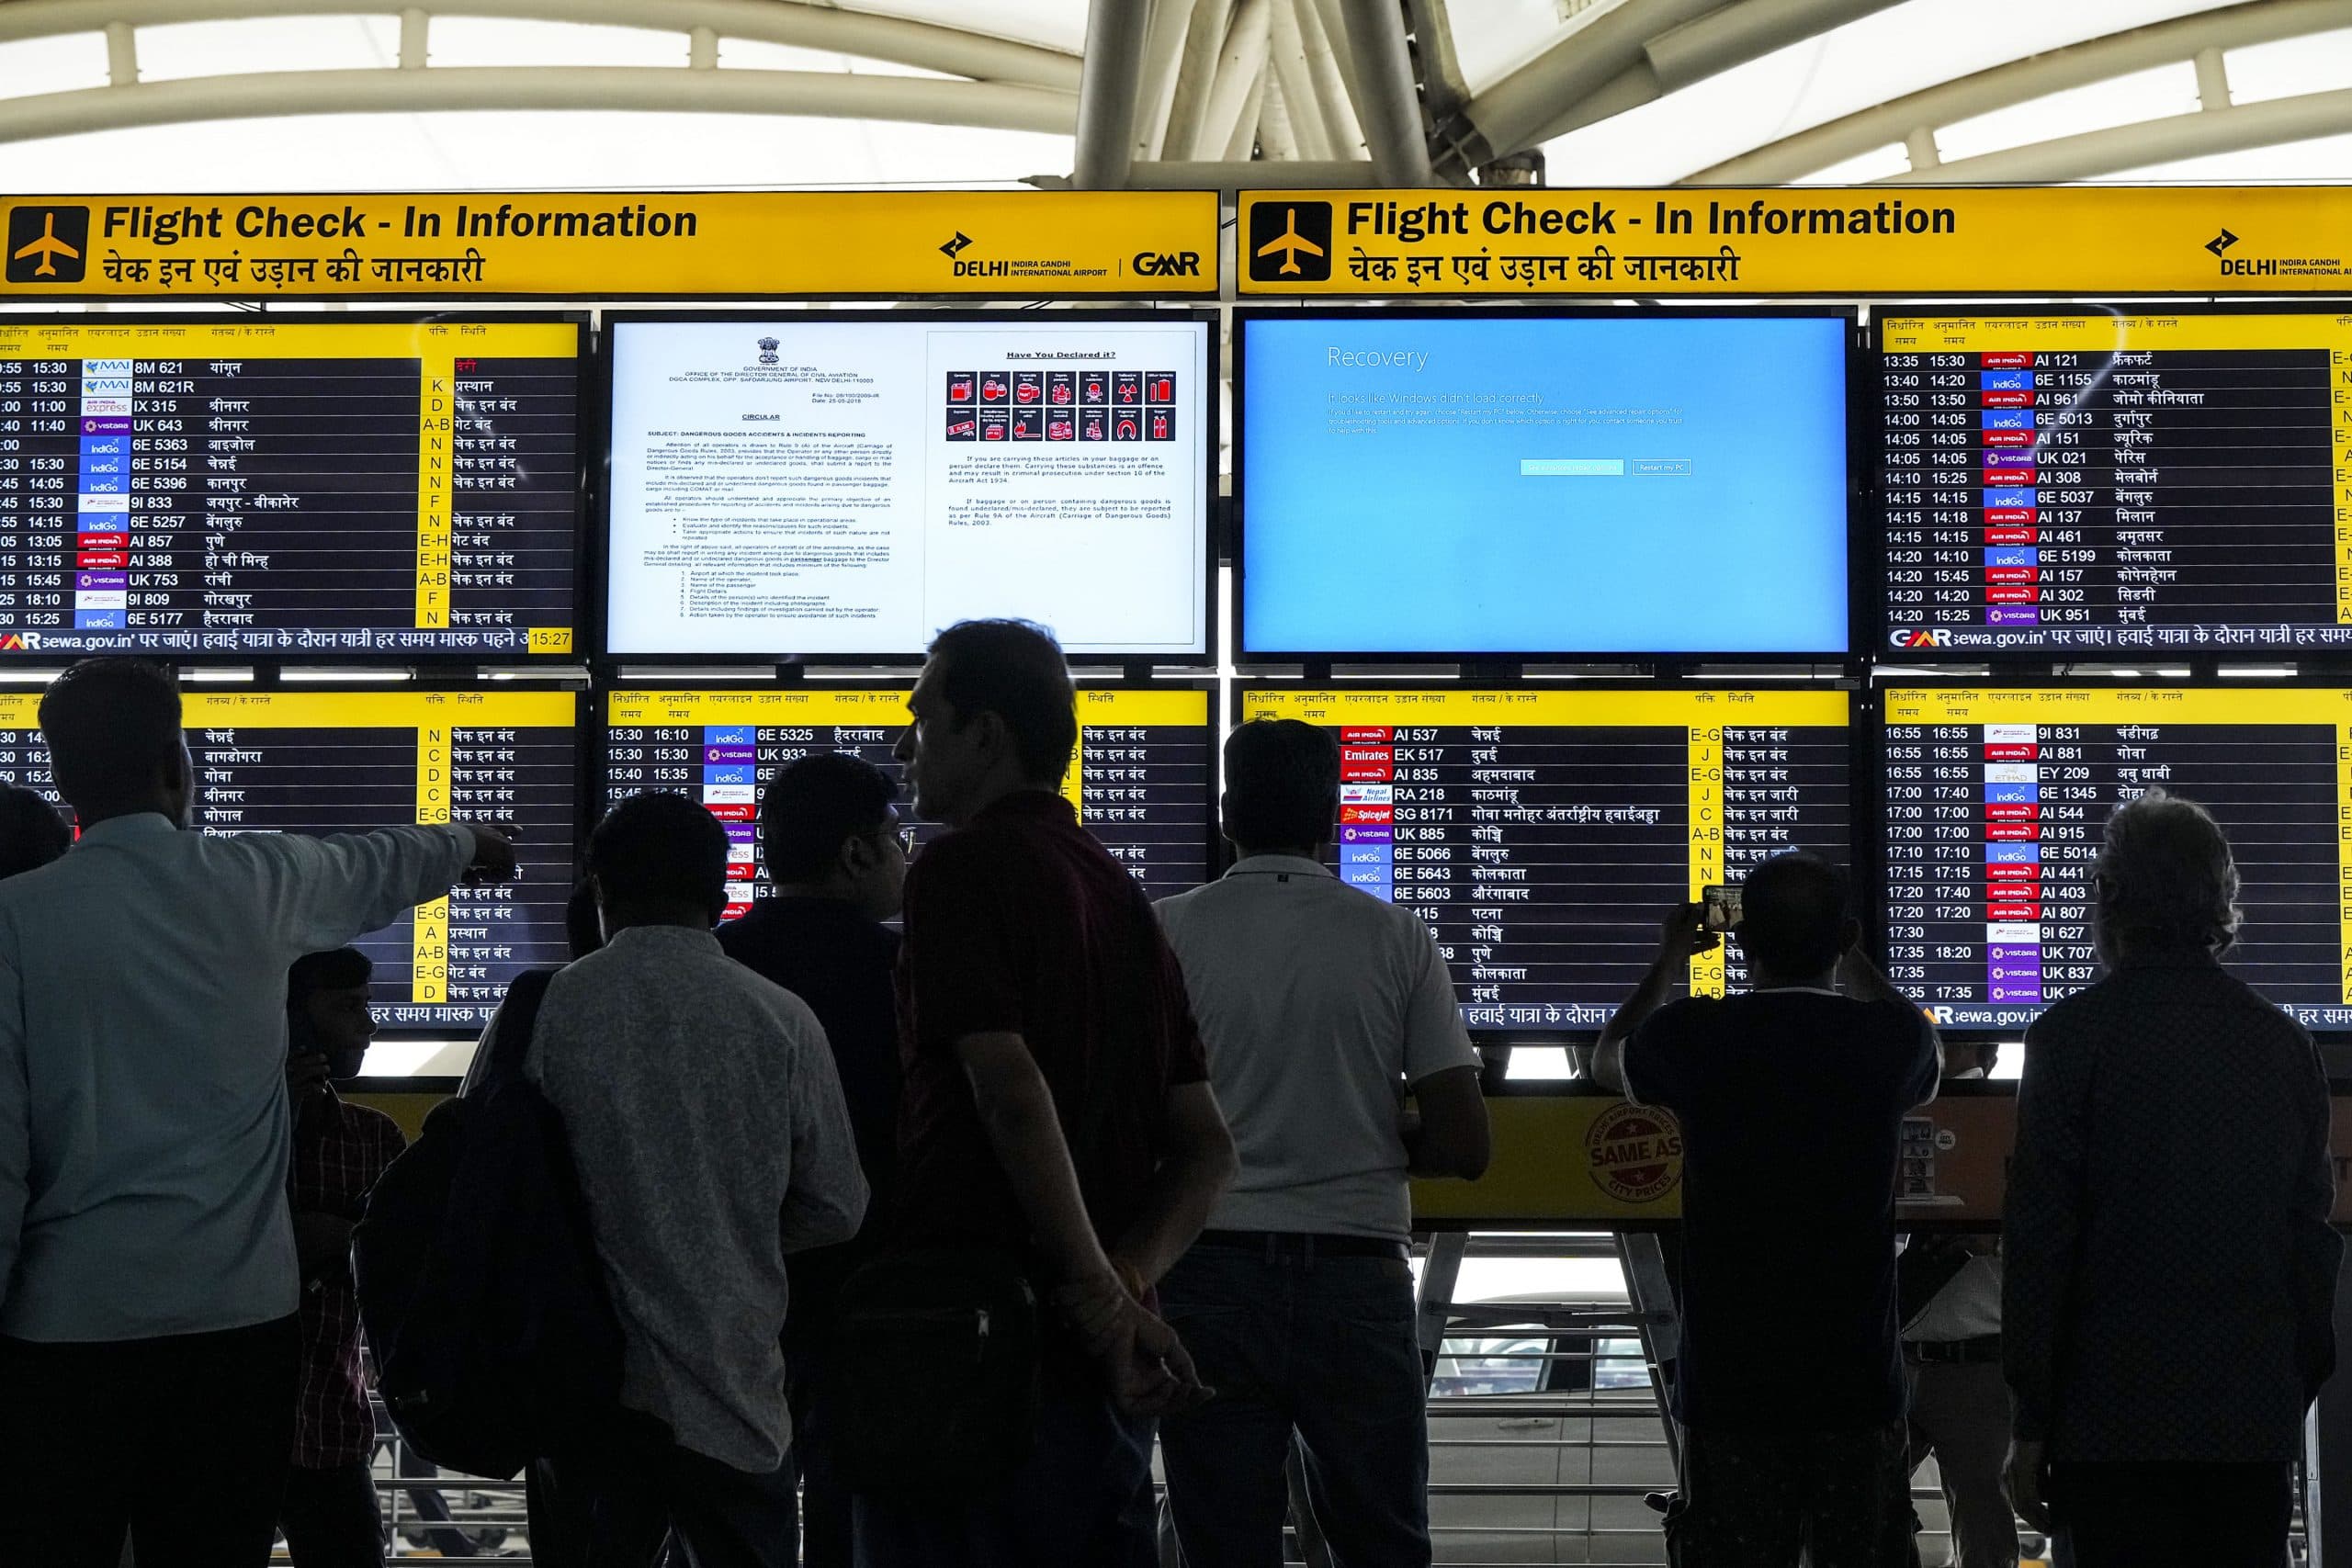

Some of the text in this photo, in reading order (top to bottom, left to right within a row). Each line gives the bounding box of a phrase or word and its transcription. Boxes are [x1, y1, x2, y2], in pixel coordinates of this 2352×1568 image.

[103, 205, 222, 244] Flight
[236, 206, 366, 237] Check
[404, 206, 441, 237] In
[457, 205, 697, 236] Information
[1348, 201, 1468, 243] Flight
[1483, 201, 1616, 234] Check
[1657, 202, 1691, 233] In
[1710, 200, 1955, 234] Information
[103, 248, 486, 288] चेक इन एवं उड़ान की जानकारी
[954, 260, 1008, 276] DELHI
[1133, 252, 1200, 276] GMR
[1349, 245, 1741, 288] चेक इन एवं उड़ान की जानकारी
[2222, 259, 2276, 276] DELHI
[1328, 346, 1430, 372] Recovery
[2035, 355, 2048, 366] AI
[2054, 355, 2076, 366] 121
[33, 362, 182, 373] 15:30 8M 621
[210, 360, 242, 377] यांगून
[456, 380, 493, 393] प्रस्थान
[209, 398, 517, 412] श्रीनगर चेक इन बंद
[1328, 392, 1544, 405] It looks like Windows didn't load correctly
[2113, 390, 2204, 406] जोमो कीनियाता
[32, 400, 442, 413] 11:00 express IX 315 D
[134, 420, 153, 431] UK
[158, 420, 182, 431] 643
[424, 419, 449, 430] A-B
[2037, 452, 2085, 464] UK 021
[207, 497, 243, 512] जयपुर
[254, 494, 299, 509] बीकानेर
[205, 552, 447, 570] हो ची मिन्ह E-H
[2039, 550, 2095, 561] 6E 5199
[2117, 547, 2172, 562] कोलकाता
[128, 614, 145, 625] 6E
[150, 613, 183, 625] 5177
[203, 610, 254, 627] हैदराबाद
[139, 634, 160, 648] पर
[162, 630, 198, 649] जाएं।
[202, 629, 239, 649] हवाई
[243, 634, 273, 648] यात्रा
[277, 629, 293, 648] के
[297, 629, 337, 648] दौरान
[341, 628, 371, 648] यात्री
[376, 633, 394, 649] हर
[400, 633, 435, 647] समय
[440, 633, 478, 647] मास्क
[483, 628, 515, 649] पहने
[532, 632, 570, 646] 15:27
[609, 729, 813, 740] 15:30 16:10 6E 5325
[834, 727, 885, 743] हैदराबाद
[1933, 728, 1968, 739] 16:55
[205, 748, 262, 763] बागडोगरा
[1345, 749, 1443, 761] Emirates EK 517
[1472, 747, 1498, 764] दुबई
[2040, 767, 2089, 779] EY 209
[2118, 765, 2171, 784] अबु धाबी
[1471, 785, 1799, 804] काठमांडू चेक इन जारी
[204, 807, 243, 821] भोपाल
[1395, 808, 1416, 819] SG
[1420, 808, 1452, 819] 8171
[1471, 806, 1660, 824] गोवा मनोहर अंतर्राष्ट्रीय हवाईअड्डा
[1472, 885, 1530, 900] औरंगाबाद
[2042, 947, 2093, 959] UK 707
[1590, 1135, 1683, 1168] SAME AS
[1609, 1174, 1671, 1198] CITY PRICES
